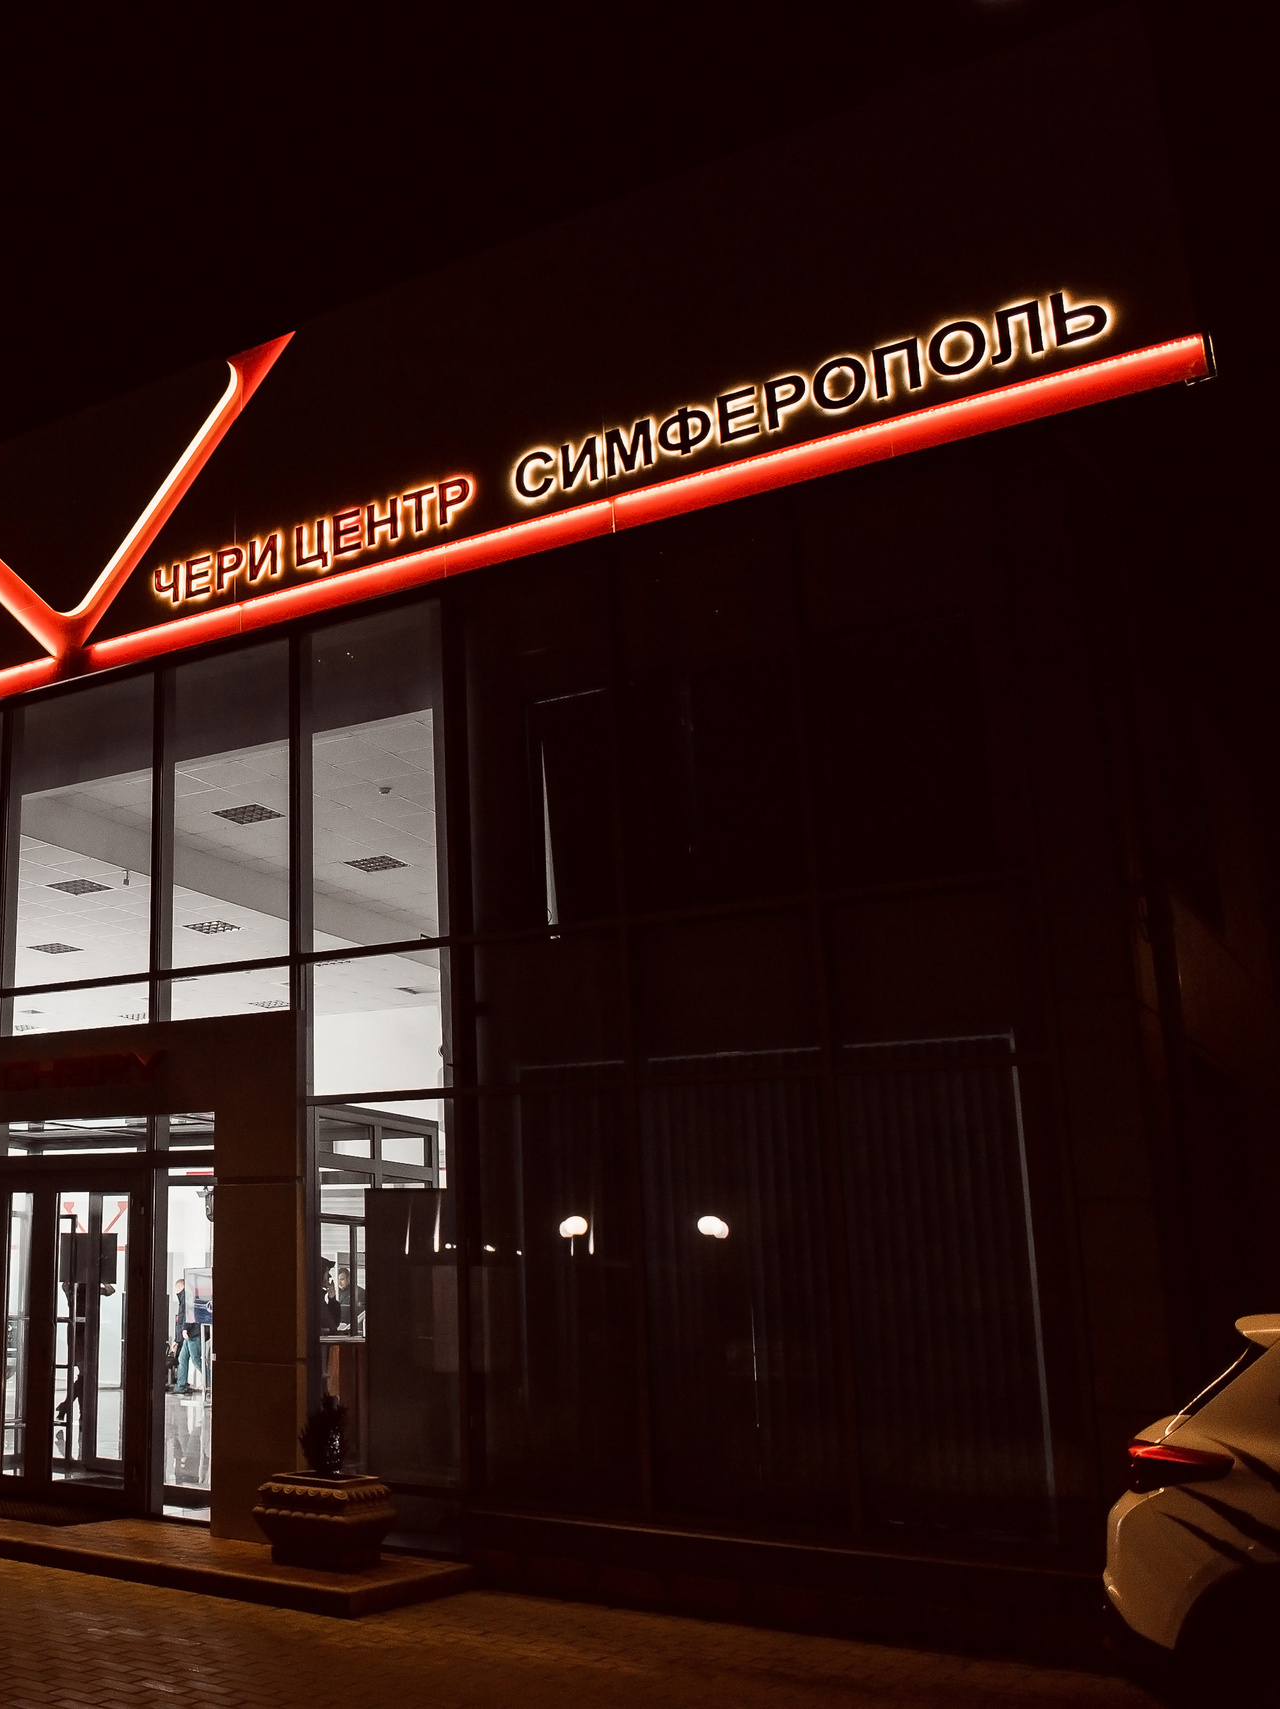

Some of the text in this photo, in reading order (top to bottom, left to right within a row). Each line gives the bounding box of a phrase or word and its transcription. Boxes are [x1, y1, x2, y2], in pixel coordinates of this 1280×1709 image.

[153, 291, 1110, 604] ЧЕРИ ЦЕНТР СИМФЕРОПОЛЬ
